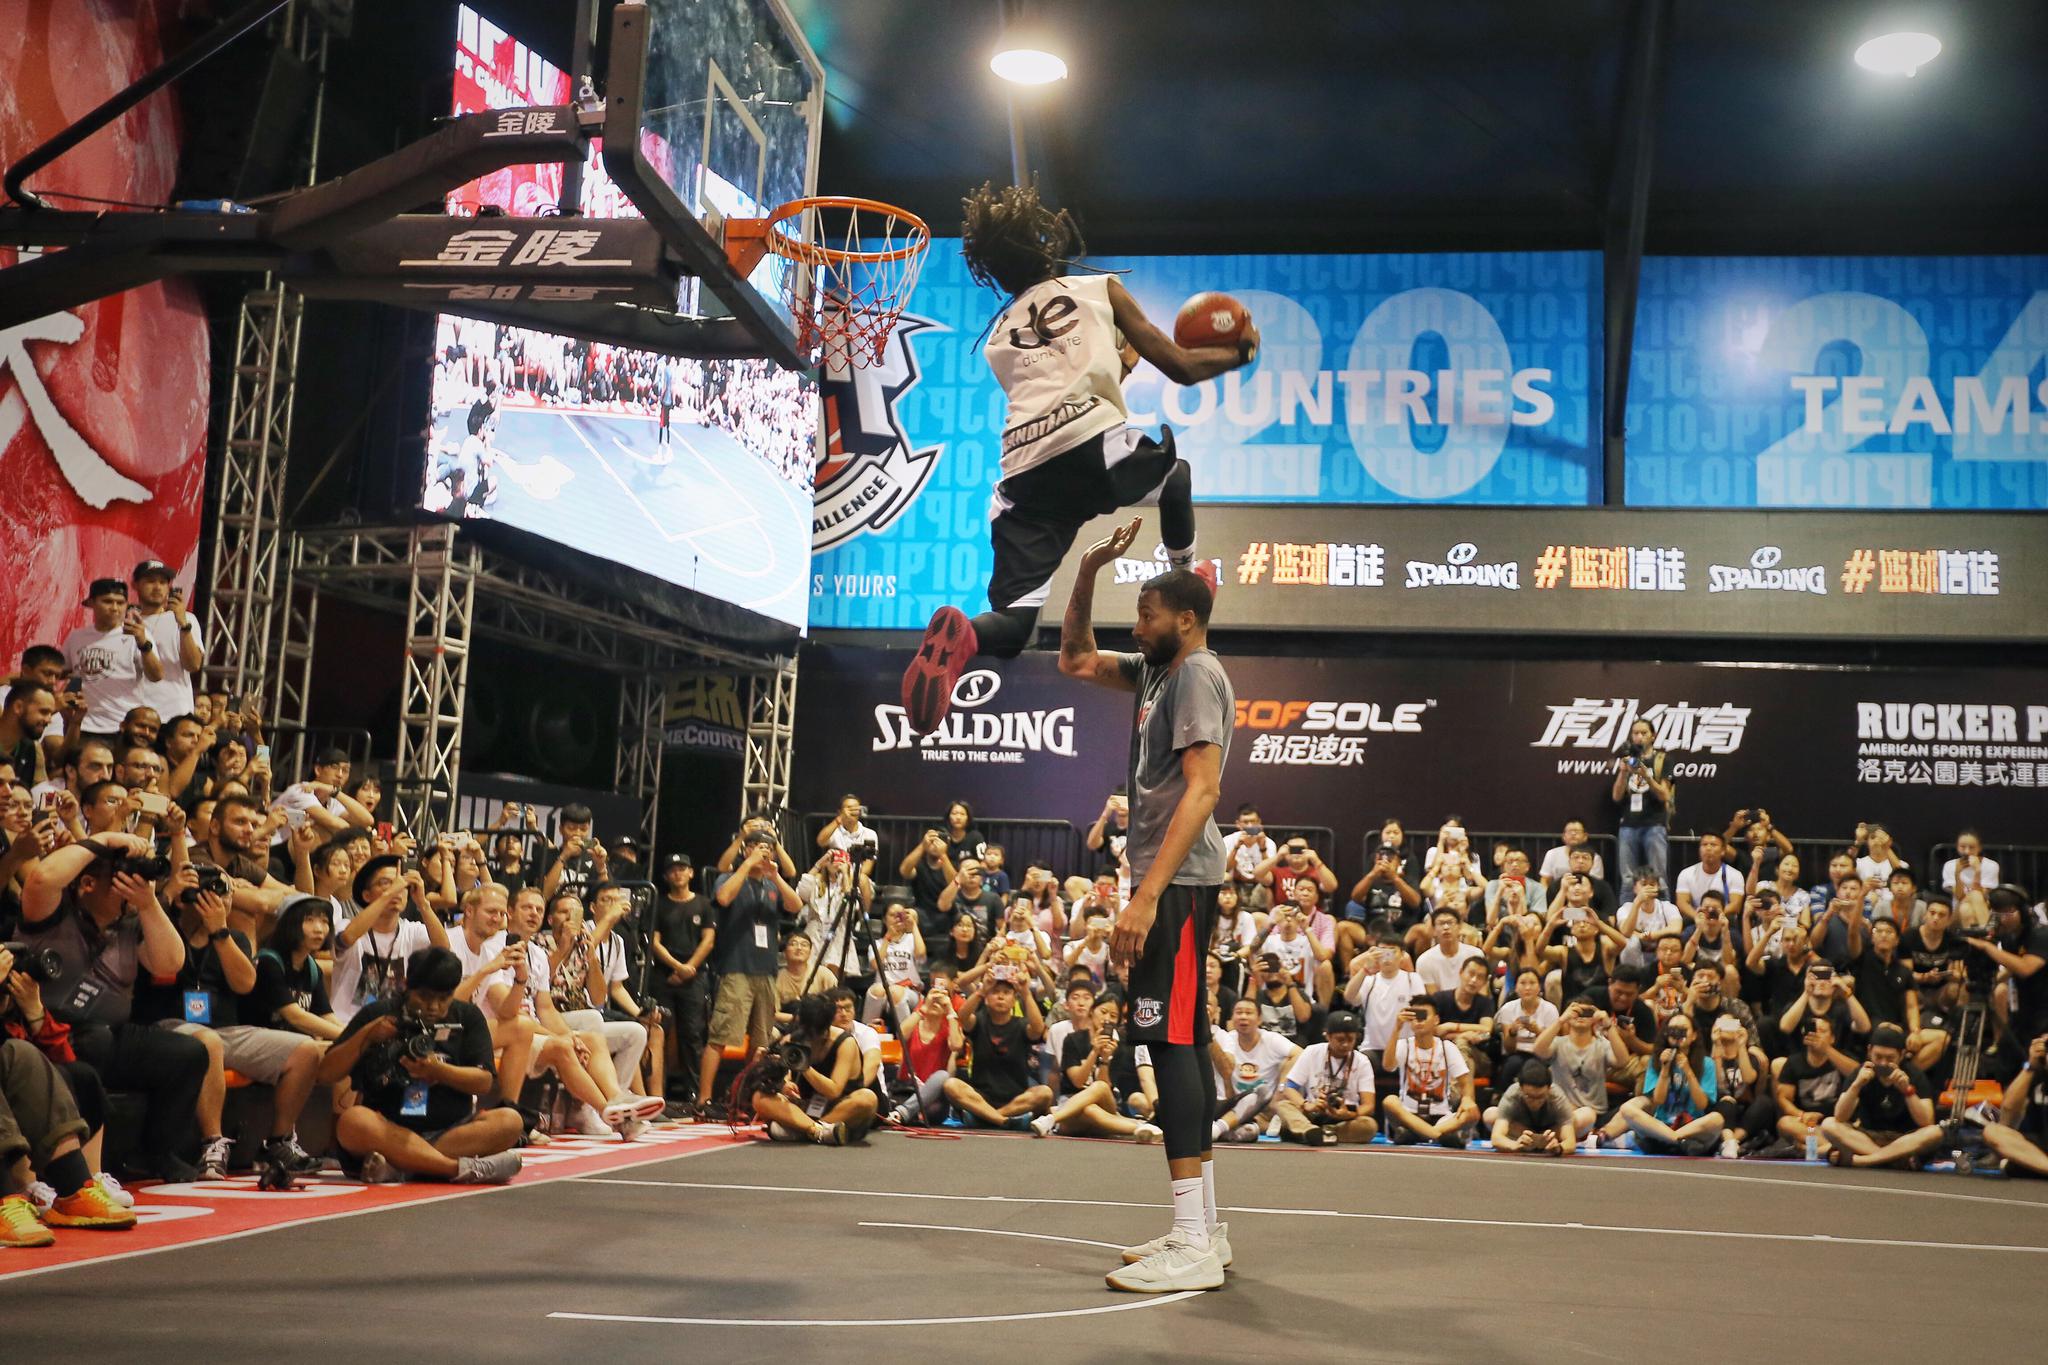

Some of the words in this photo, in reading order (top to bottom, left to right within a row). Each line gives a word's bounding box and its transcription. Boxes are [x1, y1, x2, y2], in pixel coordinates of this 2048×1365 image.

[497, 112, 557, 134] 金陵
[437, 229, 602, 267] 金陵
[1122, 368, 1555, 427] COUNTRIES
[1791, 375, 2048, 436] TEAM
[1236, 542, 1385, 587] #篮球信徒
[1404, 560, 1521, 590] SPALDING
[1533, 544, 1687, 592] #篮球信徒
[1708, 564, 1828, 596] SPALDING
[1841, 548, 2001, 596] #篮球信徒
[834, 573, 897, 598] YOURS
[1529, 697, 1752, 755] 虎扑体育
[1857, 702, 2018, 742] RUCKER
[921, 750, 950, 761] TRUE
[951, 751, 966, 762] TO
[967, 751, 988, 762] THE
[1249, 732, 1368, 767] 舒足速乐
[1858, 742, 1929, 757] AMERICAN
[1932, 744, 1983, 759] SPORTS
